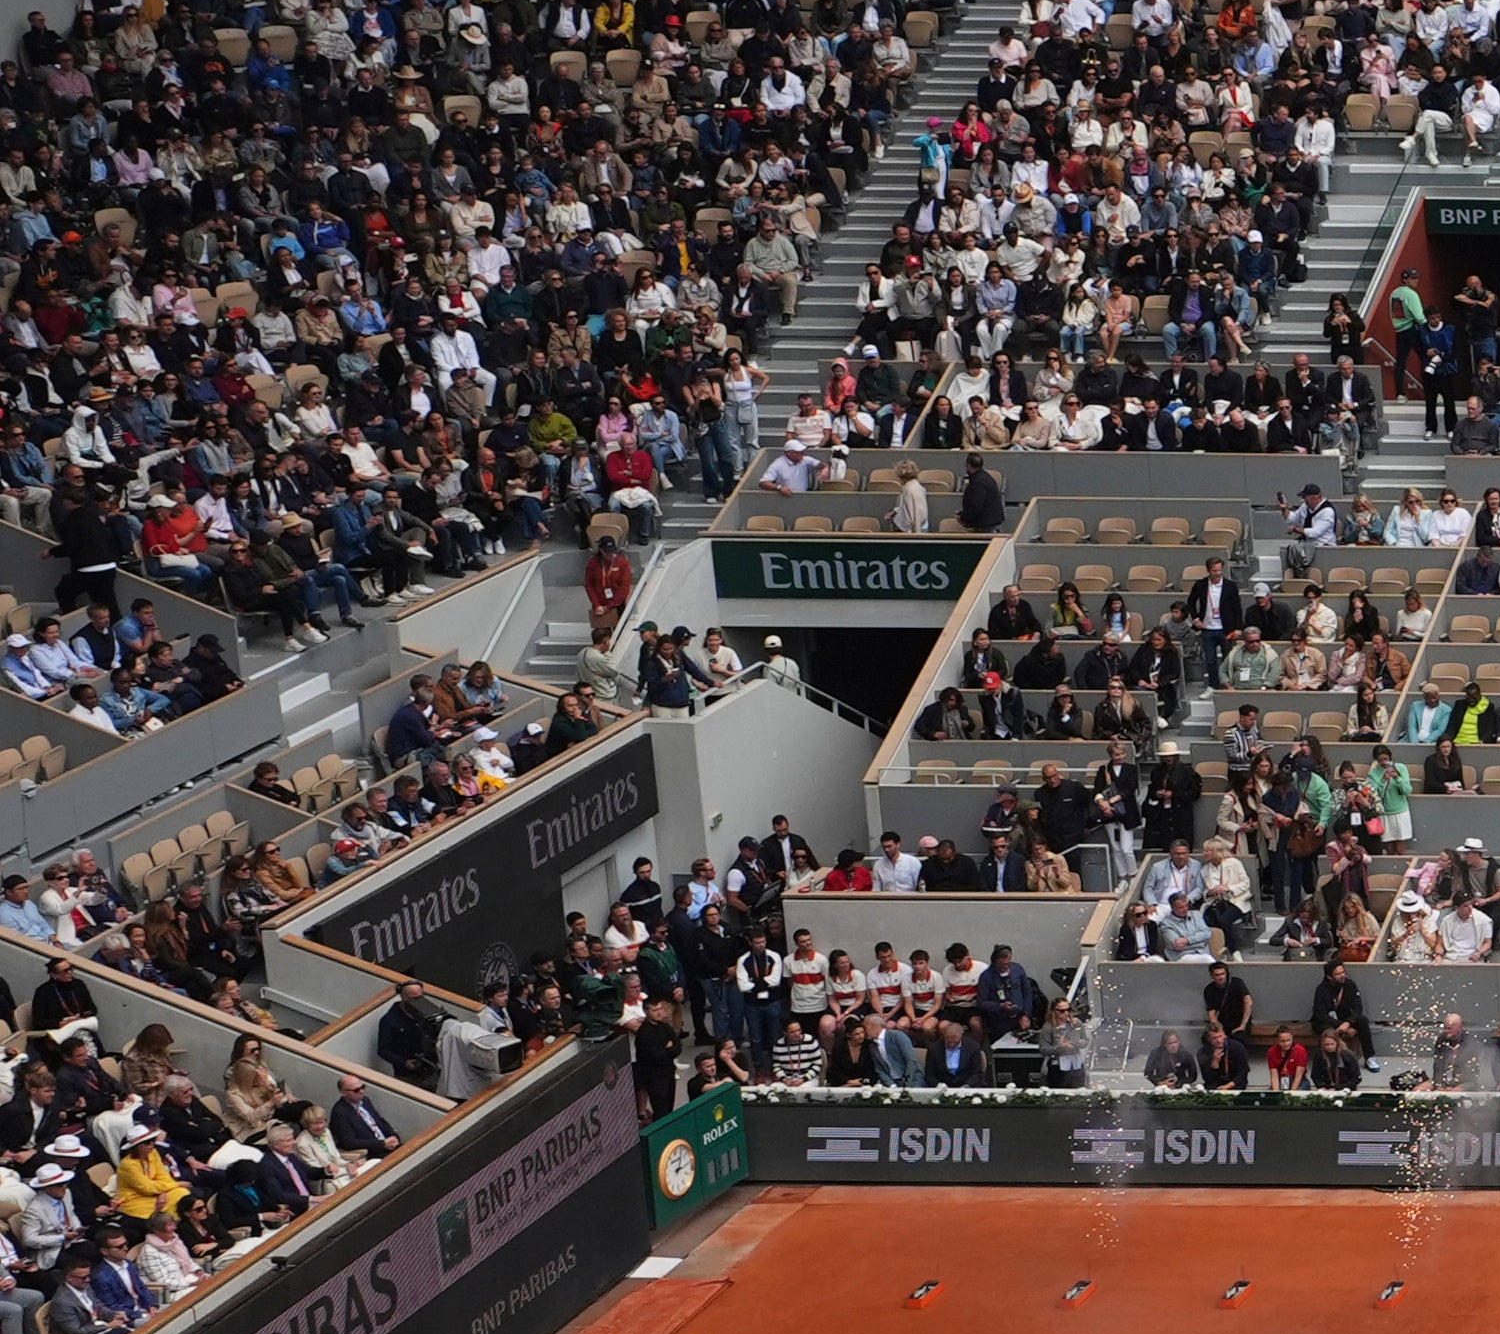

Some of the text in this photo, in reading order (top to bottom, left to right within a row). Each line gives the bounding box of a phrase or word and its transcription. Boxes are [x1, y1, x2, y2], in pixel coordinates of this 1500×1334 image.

[1439, 208, 1487, 226] BNP
[760, 551, 951, 592] Emirates
[526, 766, 639, 870] Emirates
[350, 865, 481, 967] Emirates
[702, 1115, 738, 1146] ROLEX
[889, 1126, 991, 1164] ISDIN
[1154, 1129, 1256, 1166] ISDIN
[474, 1104, 602, 1224] BNP PARIBAS
[509, 1243, 577, 1316] PARIBAS
